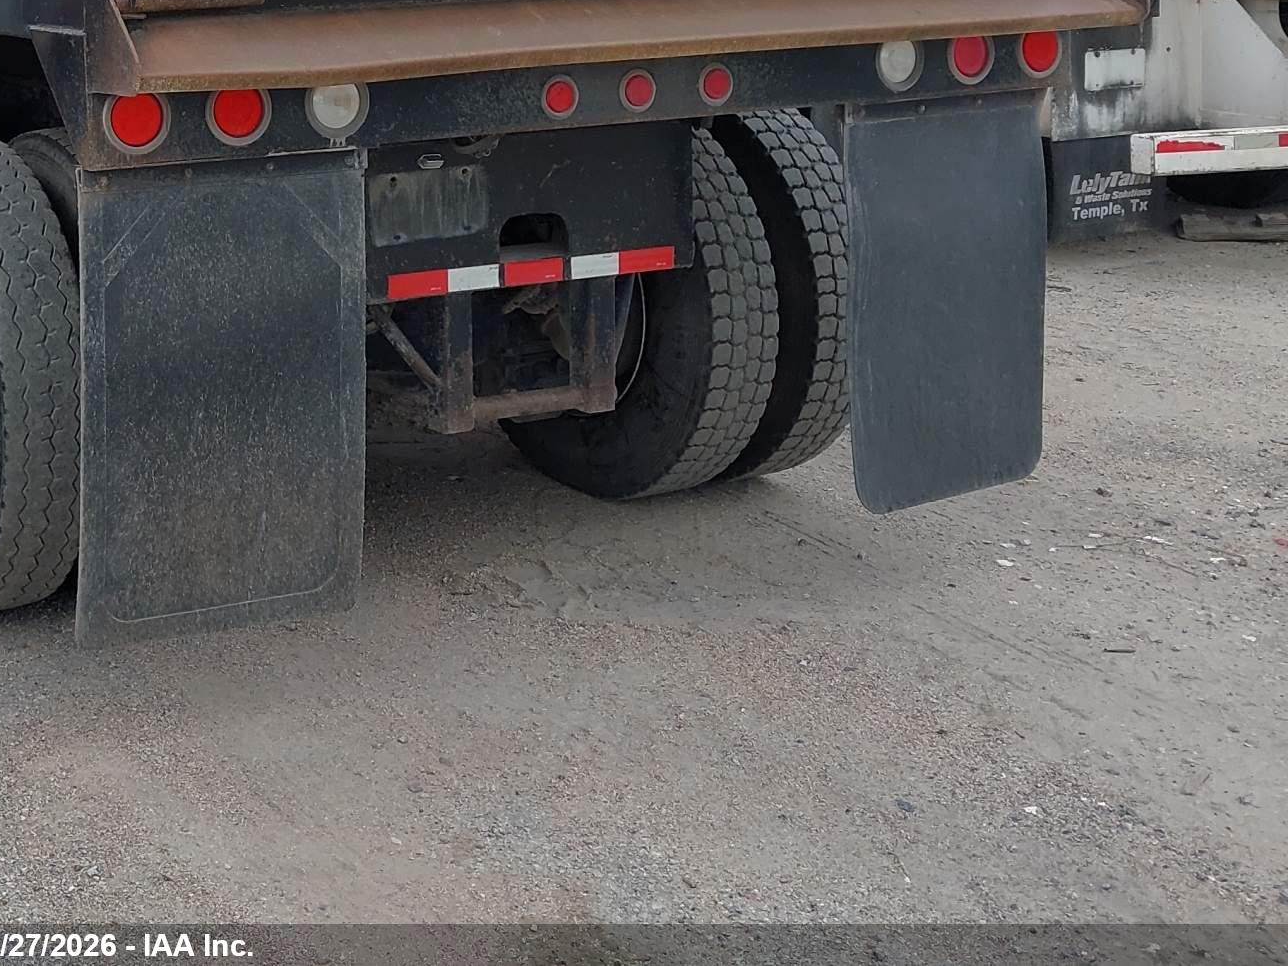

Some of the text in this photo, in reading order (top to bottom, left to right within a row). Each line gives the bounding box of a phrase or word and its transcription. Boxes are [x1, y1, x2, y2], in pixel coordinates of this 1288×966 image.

[1084, 192, 1111, 204] Waste
[1111, 188, 1153, 200] Solutions
[1071, 198, 1149, 221] Temple, Tx
